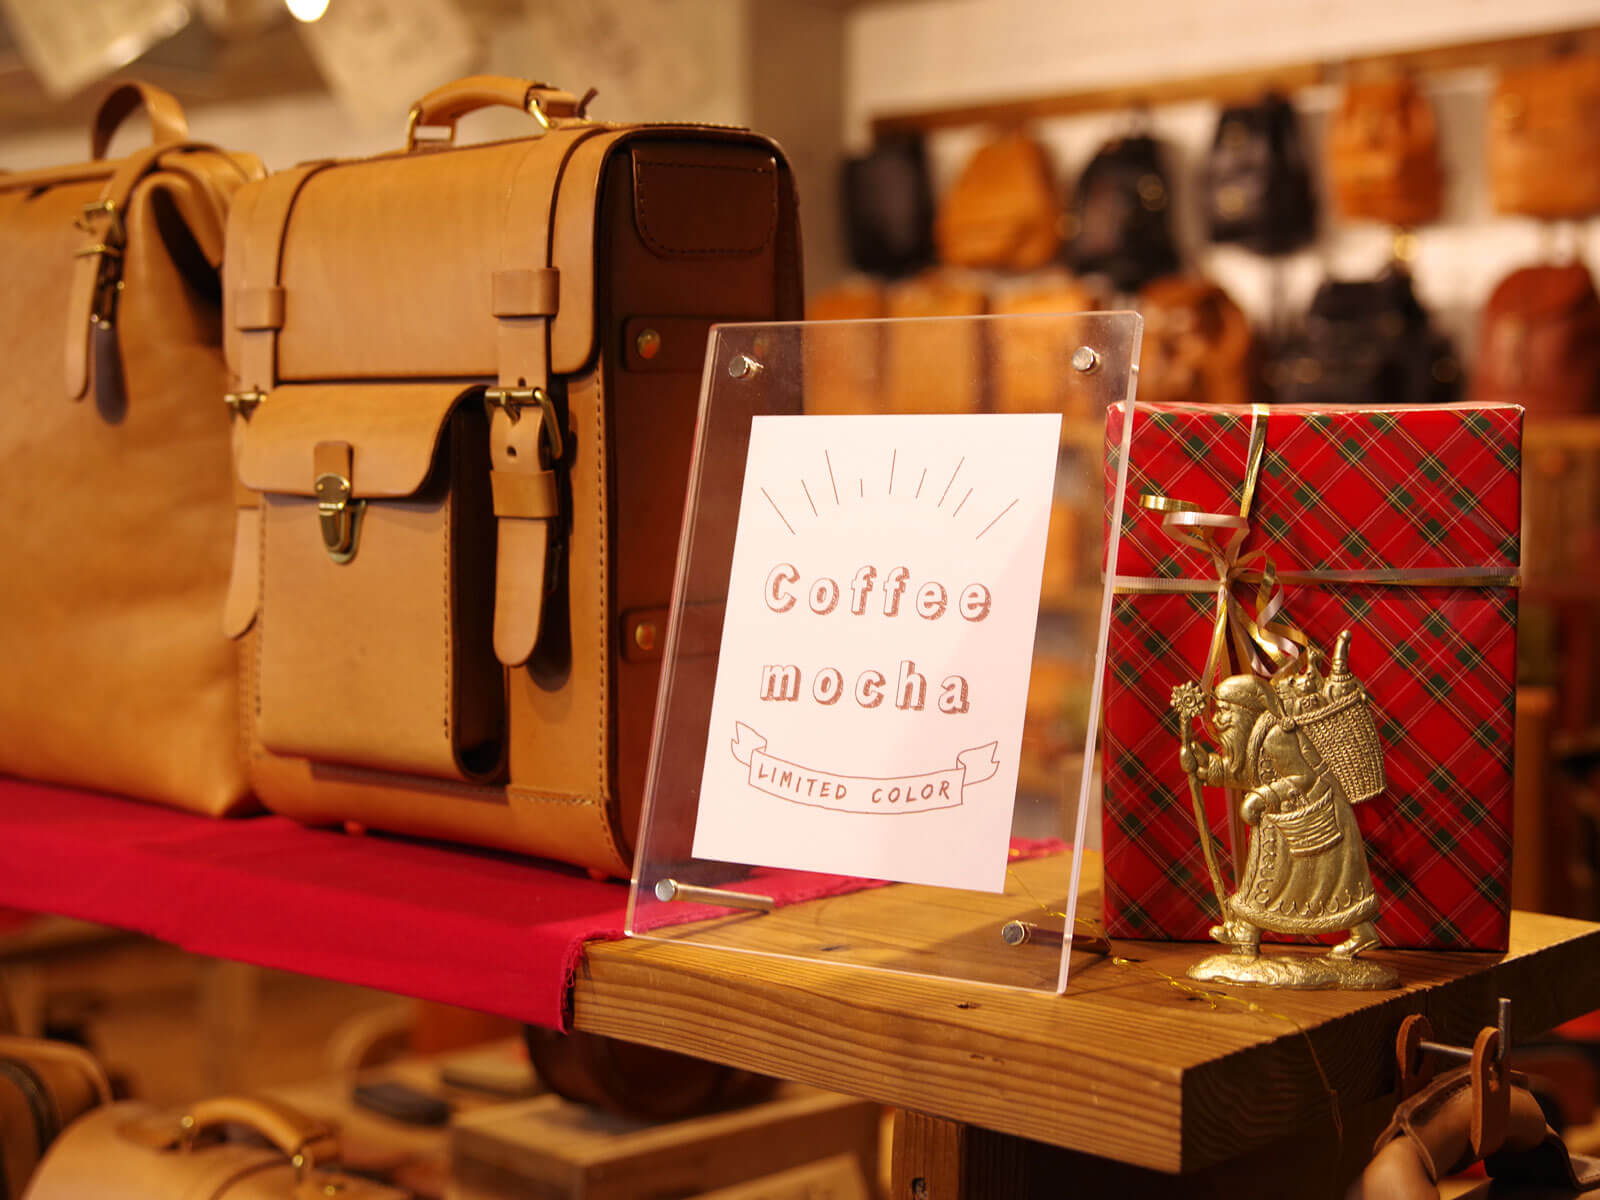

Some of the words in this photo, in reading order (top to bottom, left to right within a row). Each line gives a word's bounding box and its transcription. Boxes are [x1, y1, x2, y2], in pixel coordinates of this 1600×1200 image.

[764, 562, 992, 622] Coffee
[760, 660, 970, 714] mocha
[757, 763, 847, 800] LIMITED
[871, 780, 950, 804] COLOR
